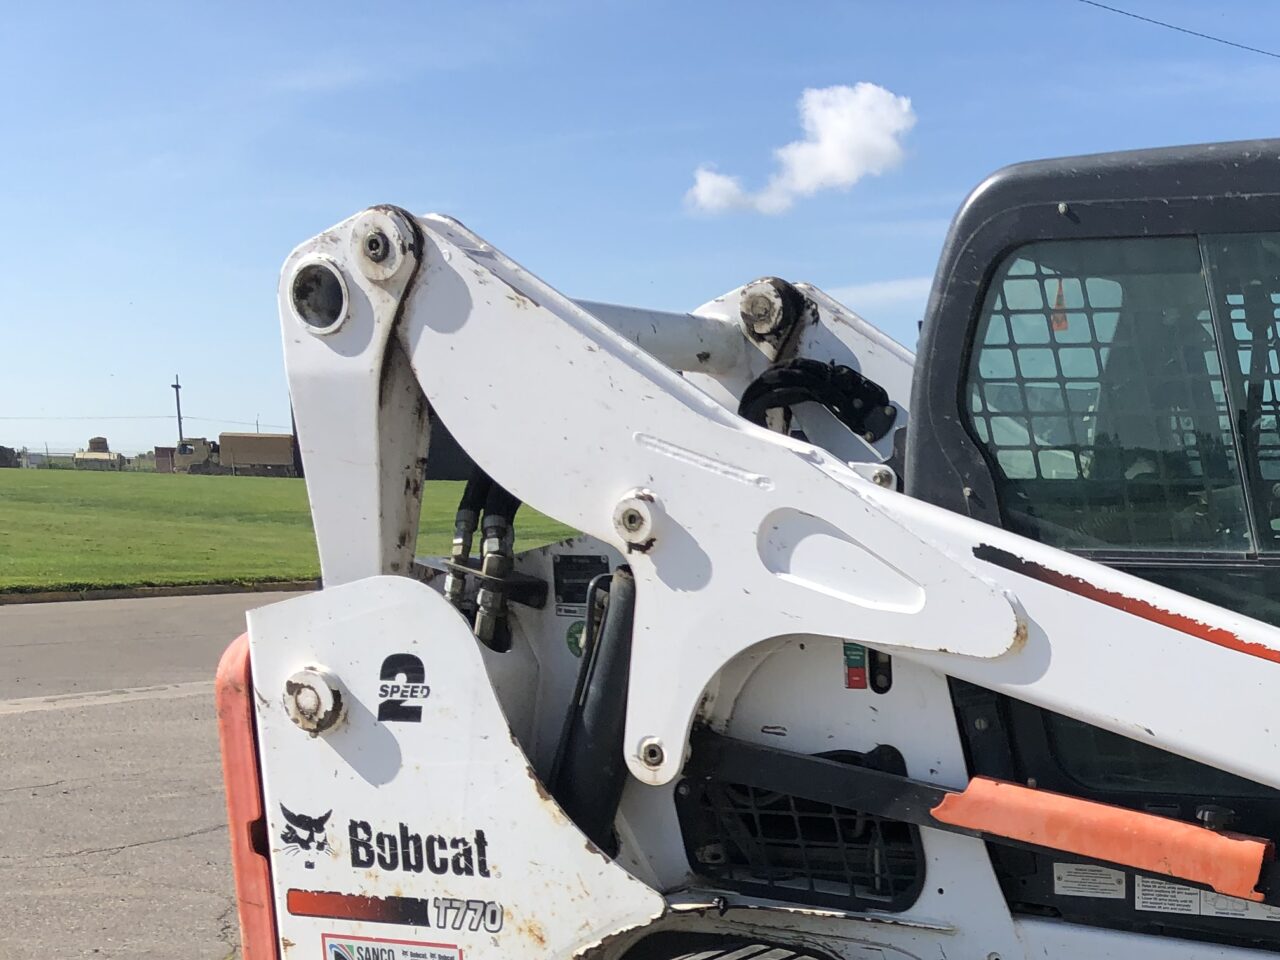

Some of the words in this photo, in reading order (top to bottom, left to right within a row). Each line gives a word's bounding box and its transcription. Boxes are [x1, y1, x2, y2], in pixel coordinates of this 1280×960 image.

[378, 684, 431, 699] SPEED
[348, 819, 490, 877] Bobcat
[434, 897, 503, 933] T770
